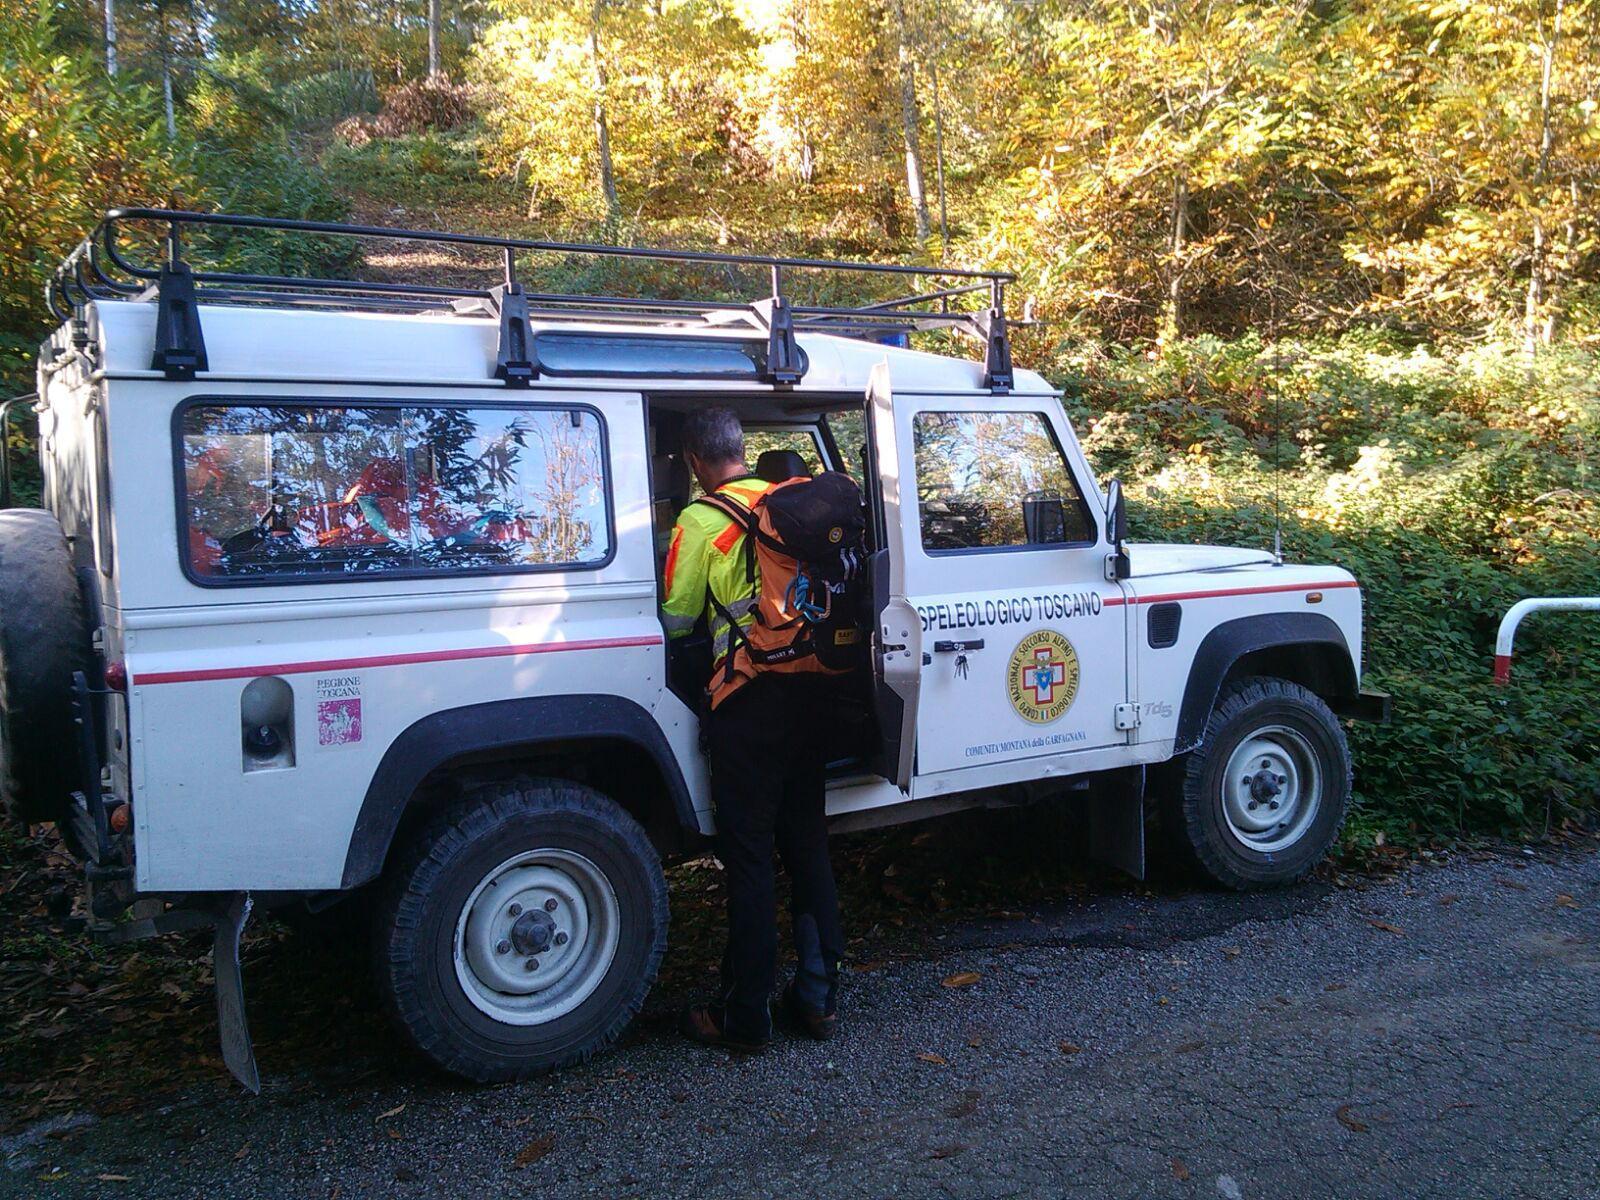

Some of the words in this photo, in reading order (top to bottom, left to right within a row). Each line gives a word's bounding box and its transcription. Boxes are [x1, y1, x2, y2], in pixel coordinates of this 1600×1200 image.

[917, 597, 1032, 632] SPELEOLOGICO
[1033, 591, 1101, 620] TOSCANO
[1018, 632, 1050, 656] SOCCORSO
[1052, 635, 1072, 657] ALPINO
[317, 677, 360, 688] REGIONE
[1010, 656, 1021, 702] NAZIONALE
[1050, 667, 1078, 717] SPELEOLOGICO
[1019, 701, 1039, 720] CORPO
